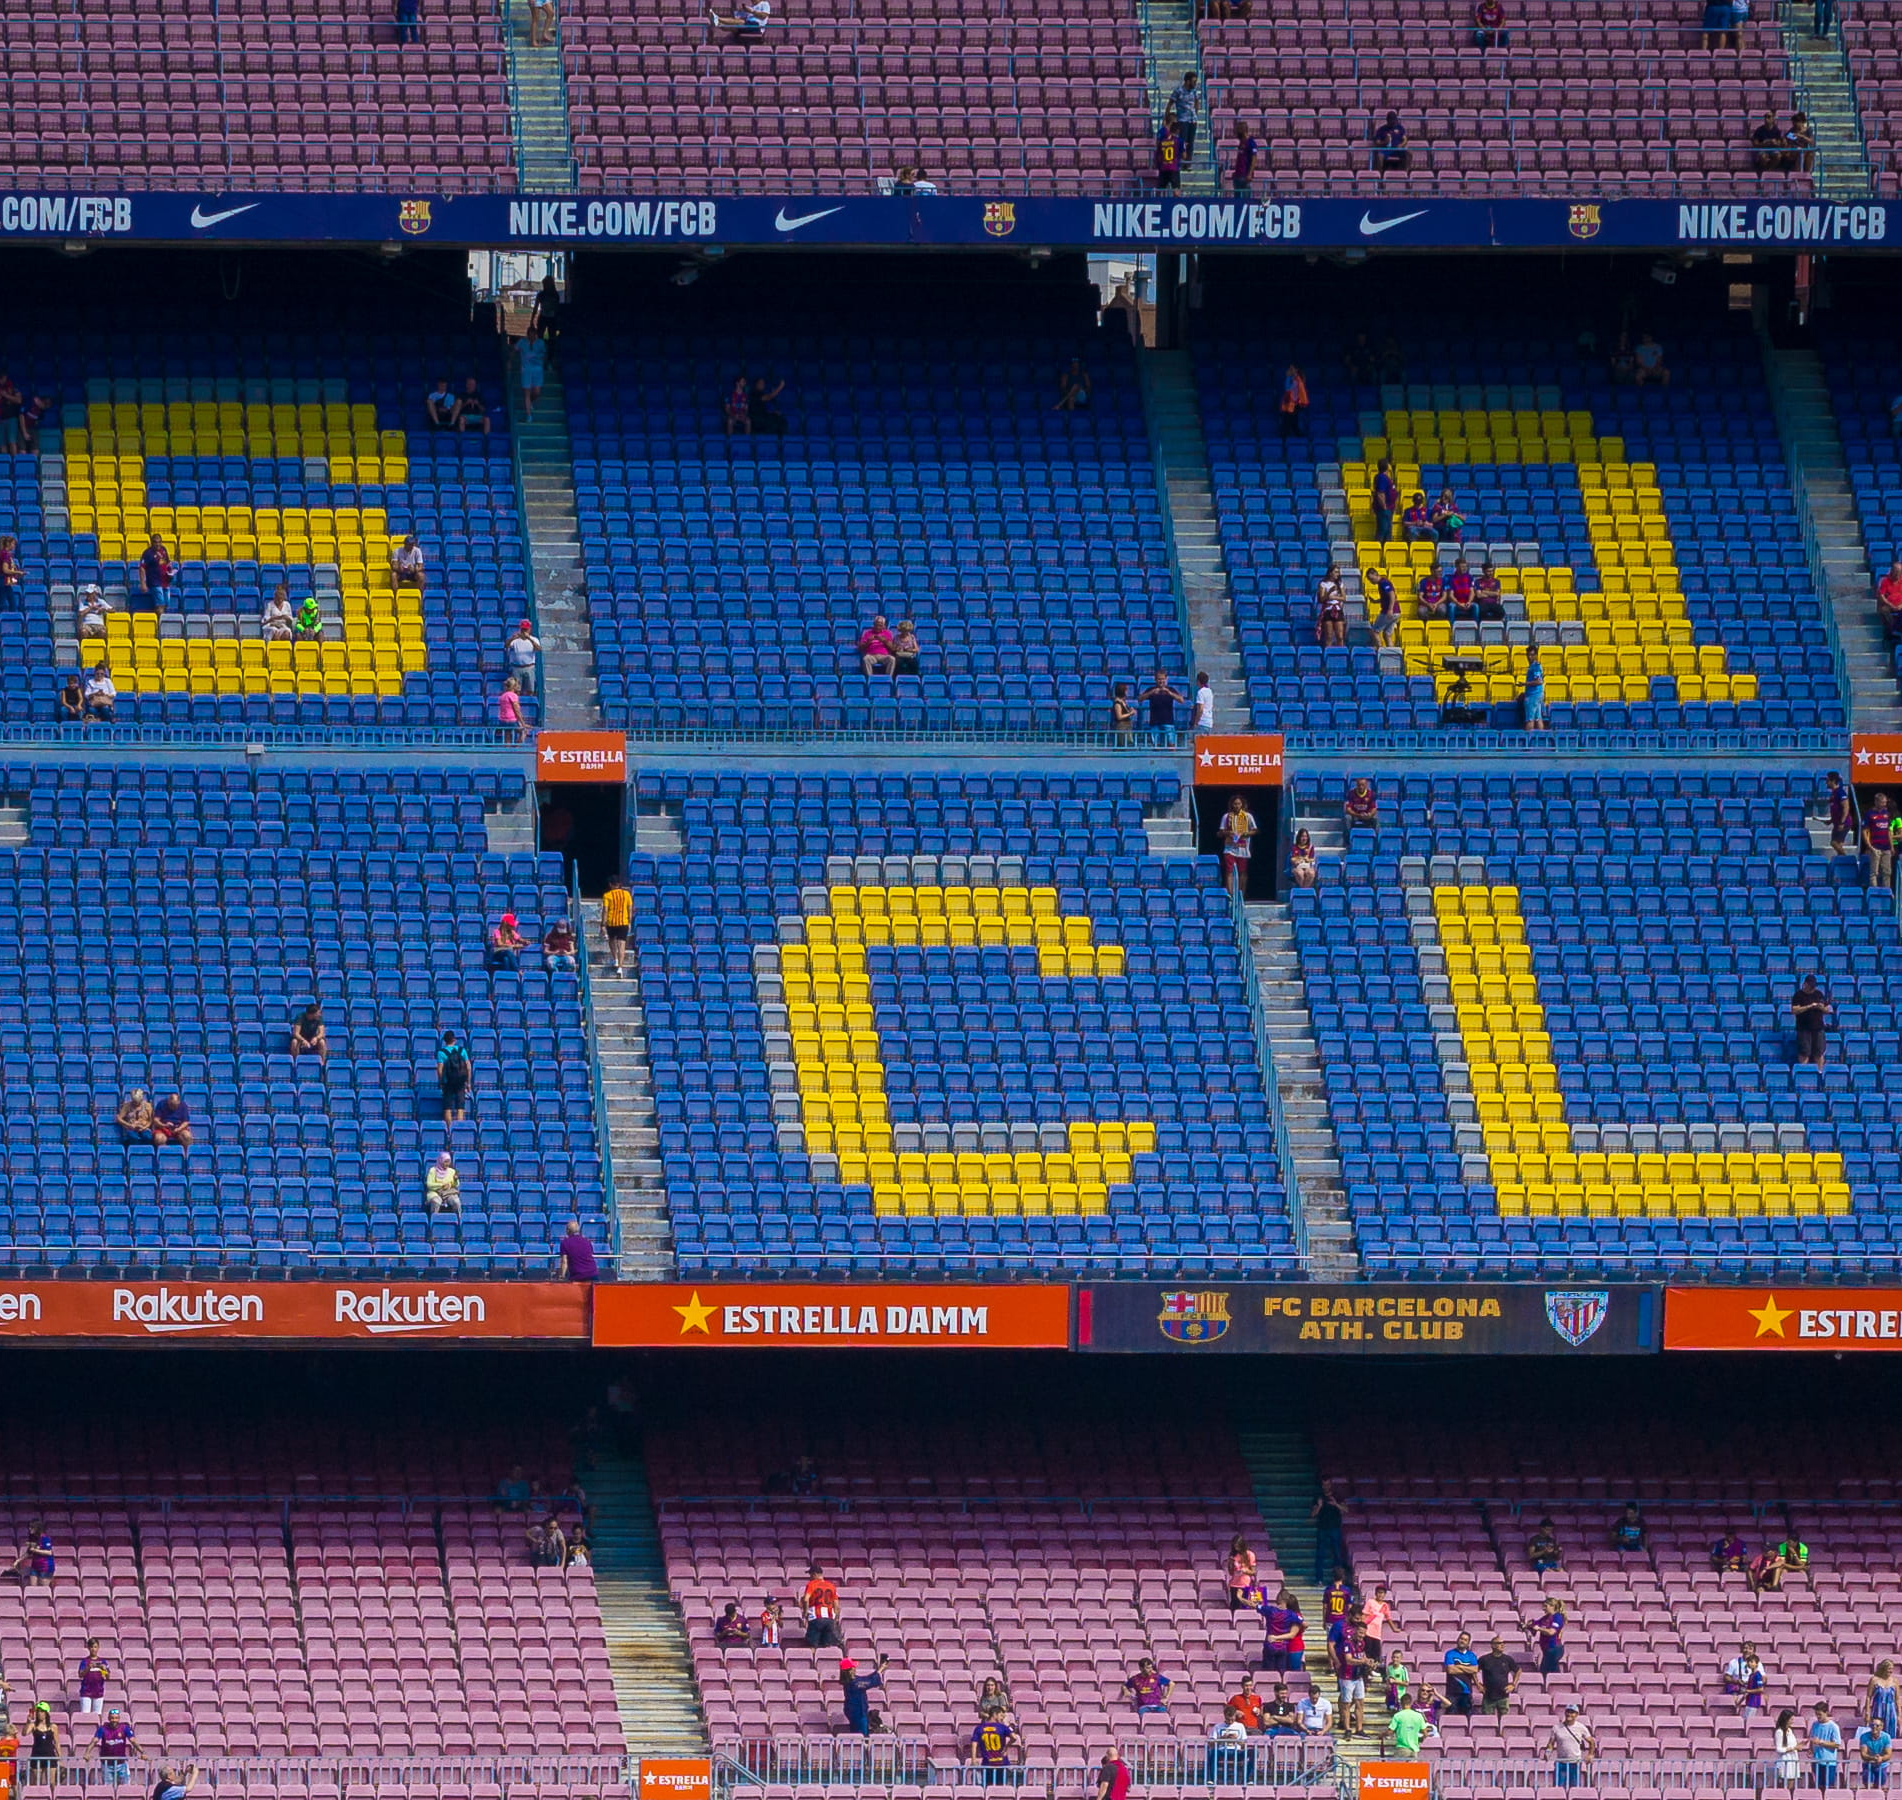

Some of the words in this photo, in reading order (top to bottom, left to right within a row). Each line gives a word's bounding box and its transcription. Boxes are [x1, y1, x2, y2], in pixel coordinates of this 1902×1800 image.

[509, 199, 718, 236] NIKE.COM/FCB
[1092, 202, 1302, 239] NIKE.COM/FCB
[1678, 203, 1886, 240] NIKE.COM/FCB
[559, 750, 625, 763] ESTRELLA
[1217, 753, 1282, 767] ESTRELLA
[113, 1287, 263, 1322] Rakuten
[335, 1288, 485, 1323] Rakuten
[1264, 1297, 1302, 1317] FC
[1310, 1297, 1502, 1317] BARCELONA
[723, 1305, 879, 1334] ESTRELLA
[886, 1306, 988, 1334] DAMM
[1298, 1320, 1374, 1340] ATH.
[1383, 1320, 1464, 1340] CLUB
[1330, 1597, 1344, 1612] 10
[982, 1733, 1001, 1751] 10
[658, 1775, 709, 1785] ESTRELLA
[1376, 1777, 1429, 1788] ESTRELLA
